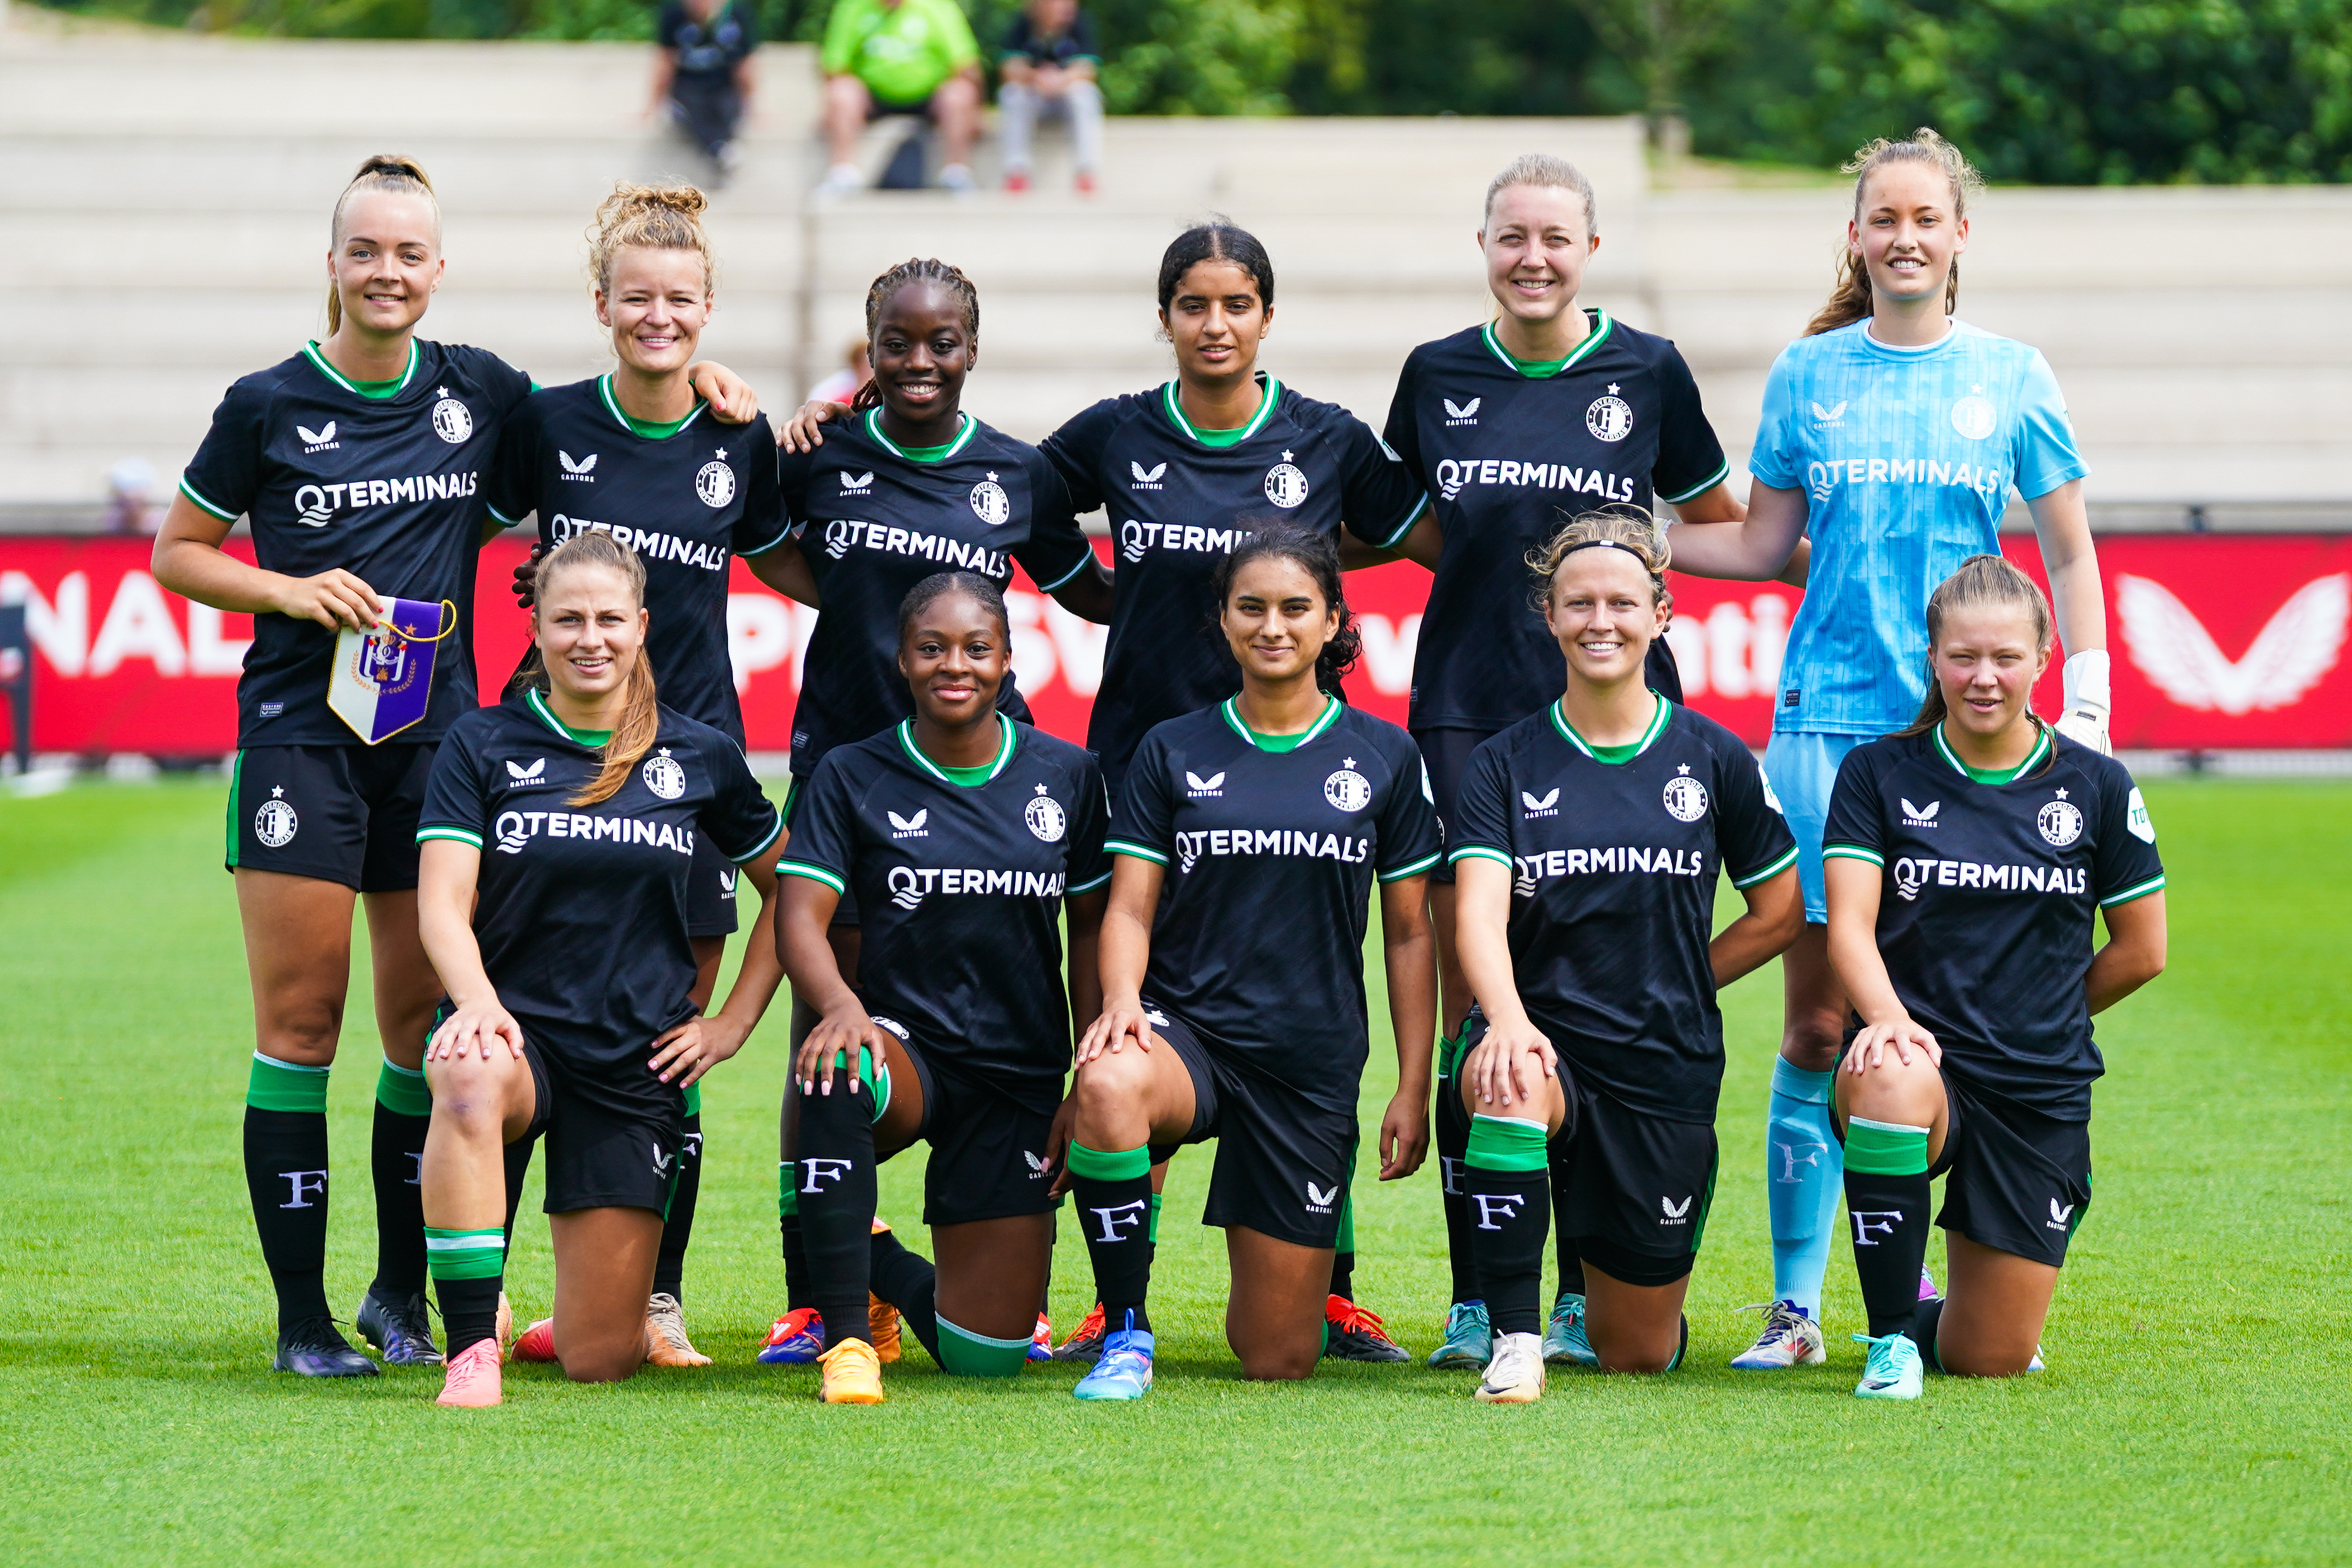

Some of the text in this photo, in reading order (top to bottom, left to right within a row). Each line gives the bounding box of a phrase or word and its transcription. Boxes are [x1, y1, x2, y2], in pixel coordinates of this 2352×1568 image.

[295, 471, 477, 527] QTERMINALS
[1436, 459, 1633, 501] QTERMINALS
[1808, 458, 1999, 502] QTERMINALS
[824, 520, 1006, 578] QTERMINALS
[496, 811, 693, 856] QTERMINALS
[1176, 829, 1368, 874] QTERMINALS
[1894, 857, 2085, 901] QTERMINALS
[800, 1158, 852, 1193] F
[1774, 1141, 1828, 1183] F
[279, 1170, 327, 1208] F
[1089, 1199, 1145, 1242] F
[1472, 1194, 1525, 1229] F
[1851, 1210, 1903, 1245] F
